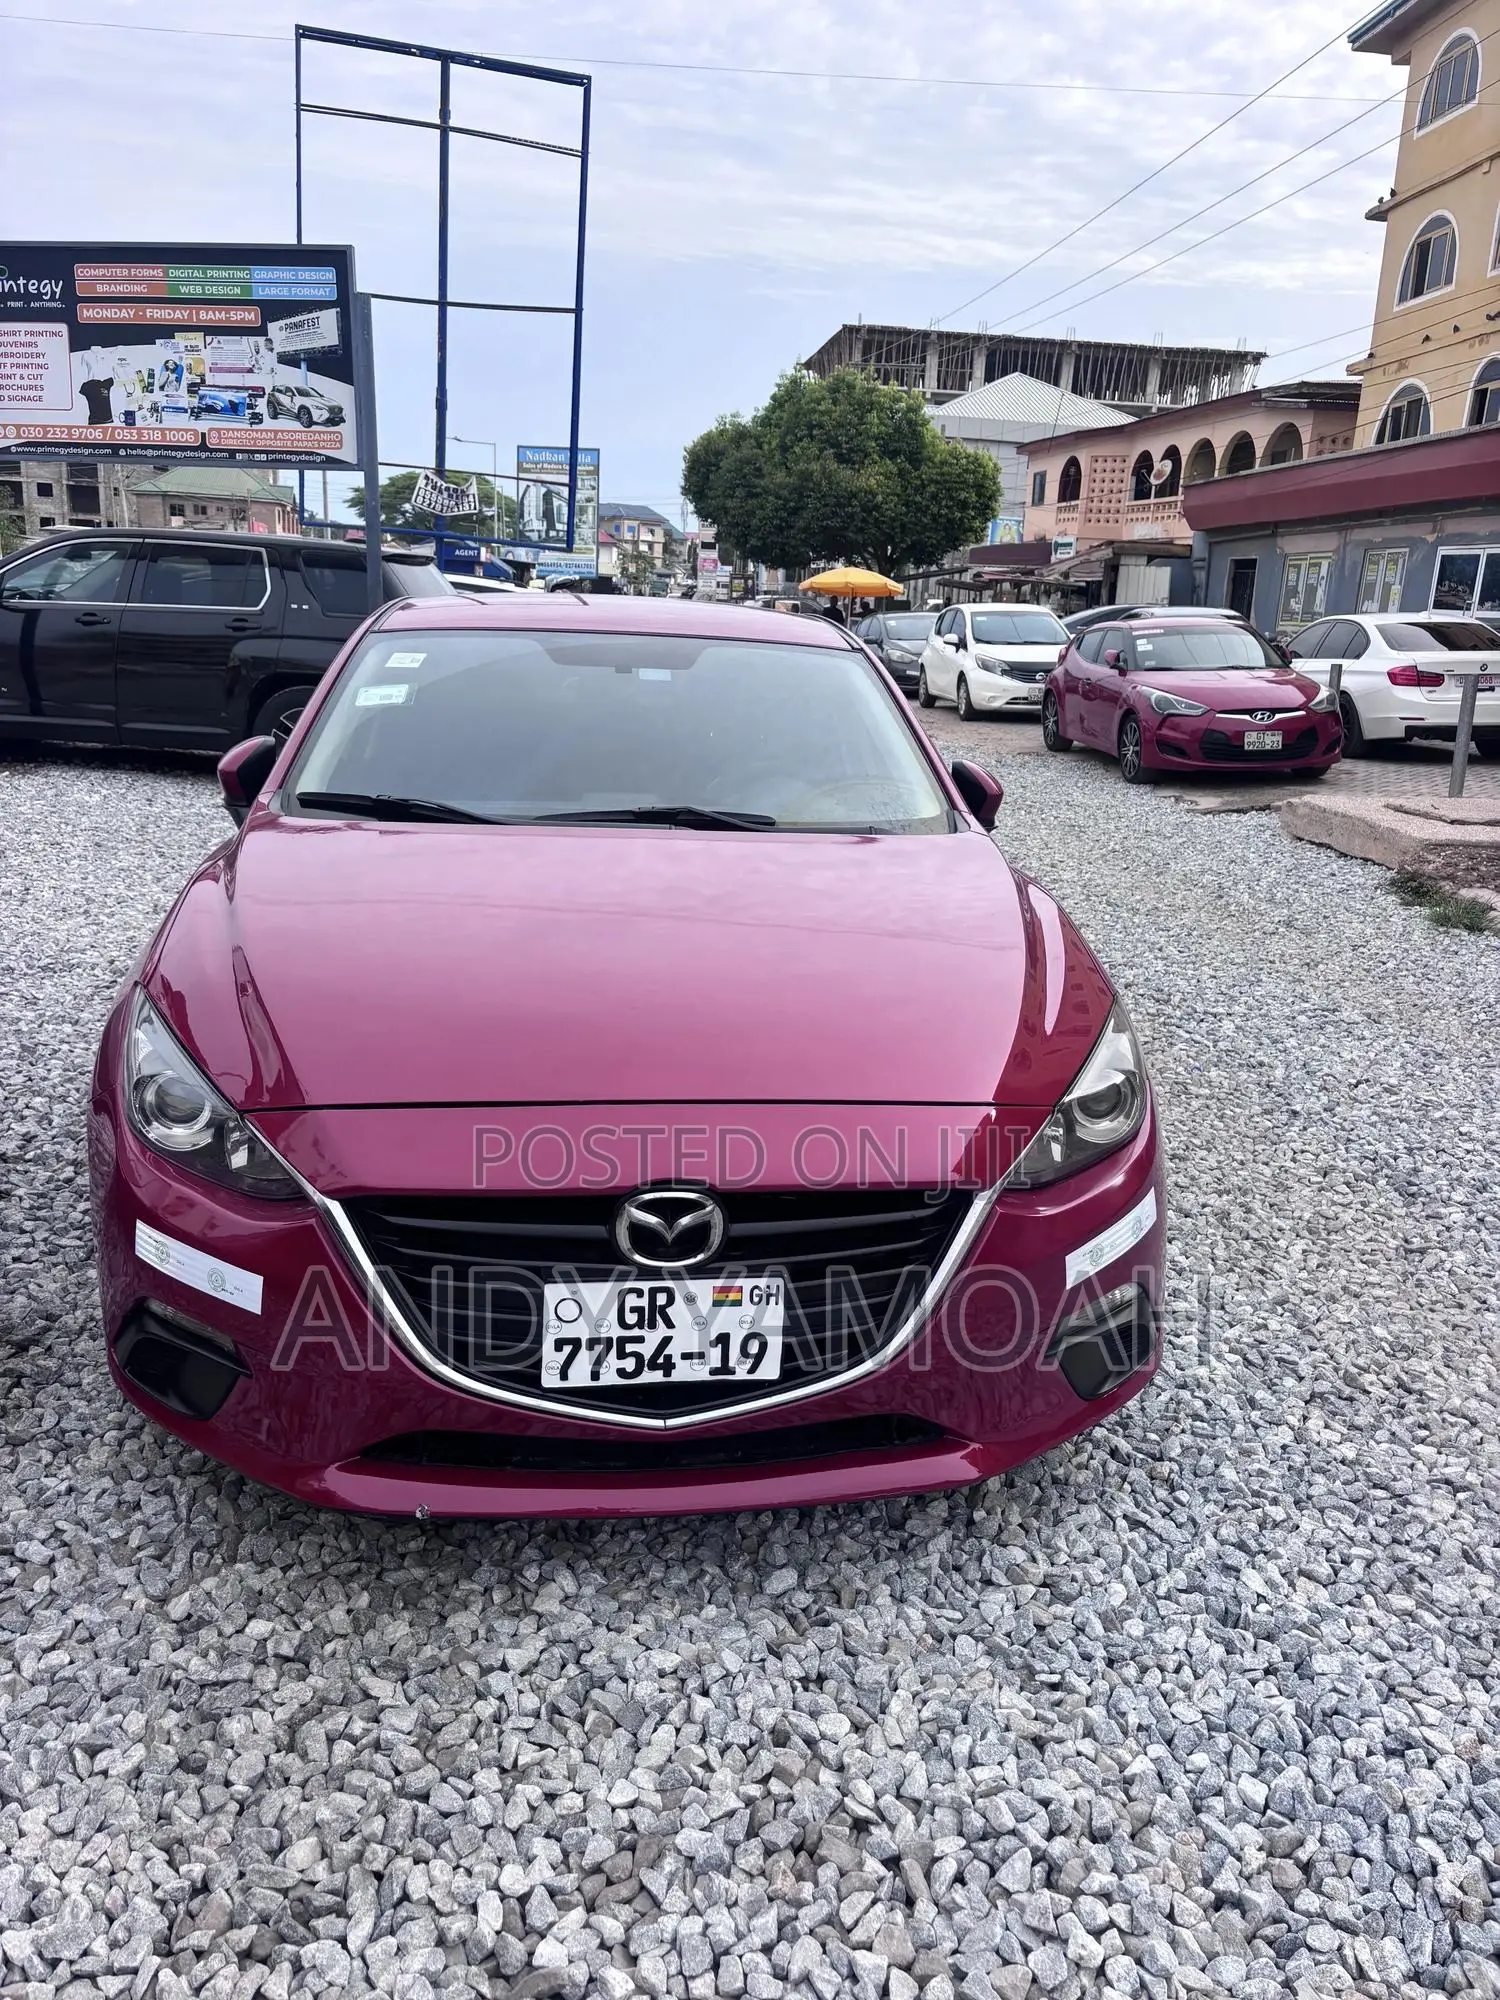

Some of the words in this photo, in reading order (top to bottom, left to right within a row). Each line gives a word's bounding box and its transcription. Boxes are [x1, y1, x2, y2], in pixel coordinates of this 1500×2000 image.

[77, 268, 129, 277] COMPUTER
[131, 269, 164, 278] FORMS
[168, 269, 205, 278] DIGITAL
[207, 269, 250, 279] PRINTING
[254, 271, 296, 280] GRAPHIC
[298, 271, 333, 280] DESIGN
[96, 284, 148, 293] BRANDING
[179, 285, 202, 294] WEB
[205, 286, 241, 294] DESIGN
[259, 287, 289, 296] LARGE
[291, 287, 331, 296] FORMAT
[83, 308, 135, 318] MONDAY
[146, 309, 189, 319] FRIDAY
[199, 310, 255, 320] 8AM-5PM
[284, 316, 321, 332] PANAFEST
[24, 330, 64, 338] PRINTING
[10, 362, 49, 370] PRINTING
[27, 373, 44, 381] CUT
[7, 394, 44, 402] SIGNAGE
[20, 427, 43, 438] 030
[46, 427, 69, 438] 232
[72, 428, 103, 439] 9706
[115, 429, 138, 440] 053
[141, 430, 161, 441] 318
[165, 430, 195, 442] 1006
[221, 430, 274, 439] DANSOMAN
[277, 431, 341, 441] ASOREDANHO
[17, 446, 112, 455] www.printegydesign.com
[127, 448, 229, 458] hello@printegydesign.com
[268, 452, 326, 462] printegydesign
[1256, 732, 1266, 741] GT
[1246, 740, 1280, 748] 9920-23
[617, 1286, 676, 1331] GR
[749, 1284, 781, 1306] GH
[554, 1331, 769, 1382] 7754-19
